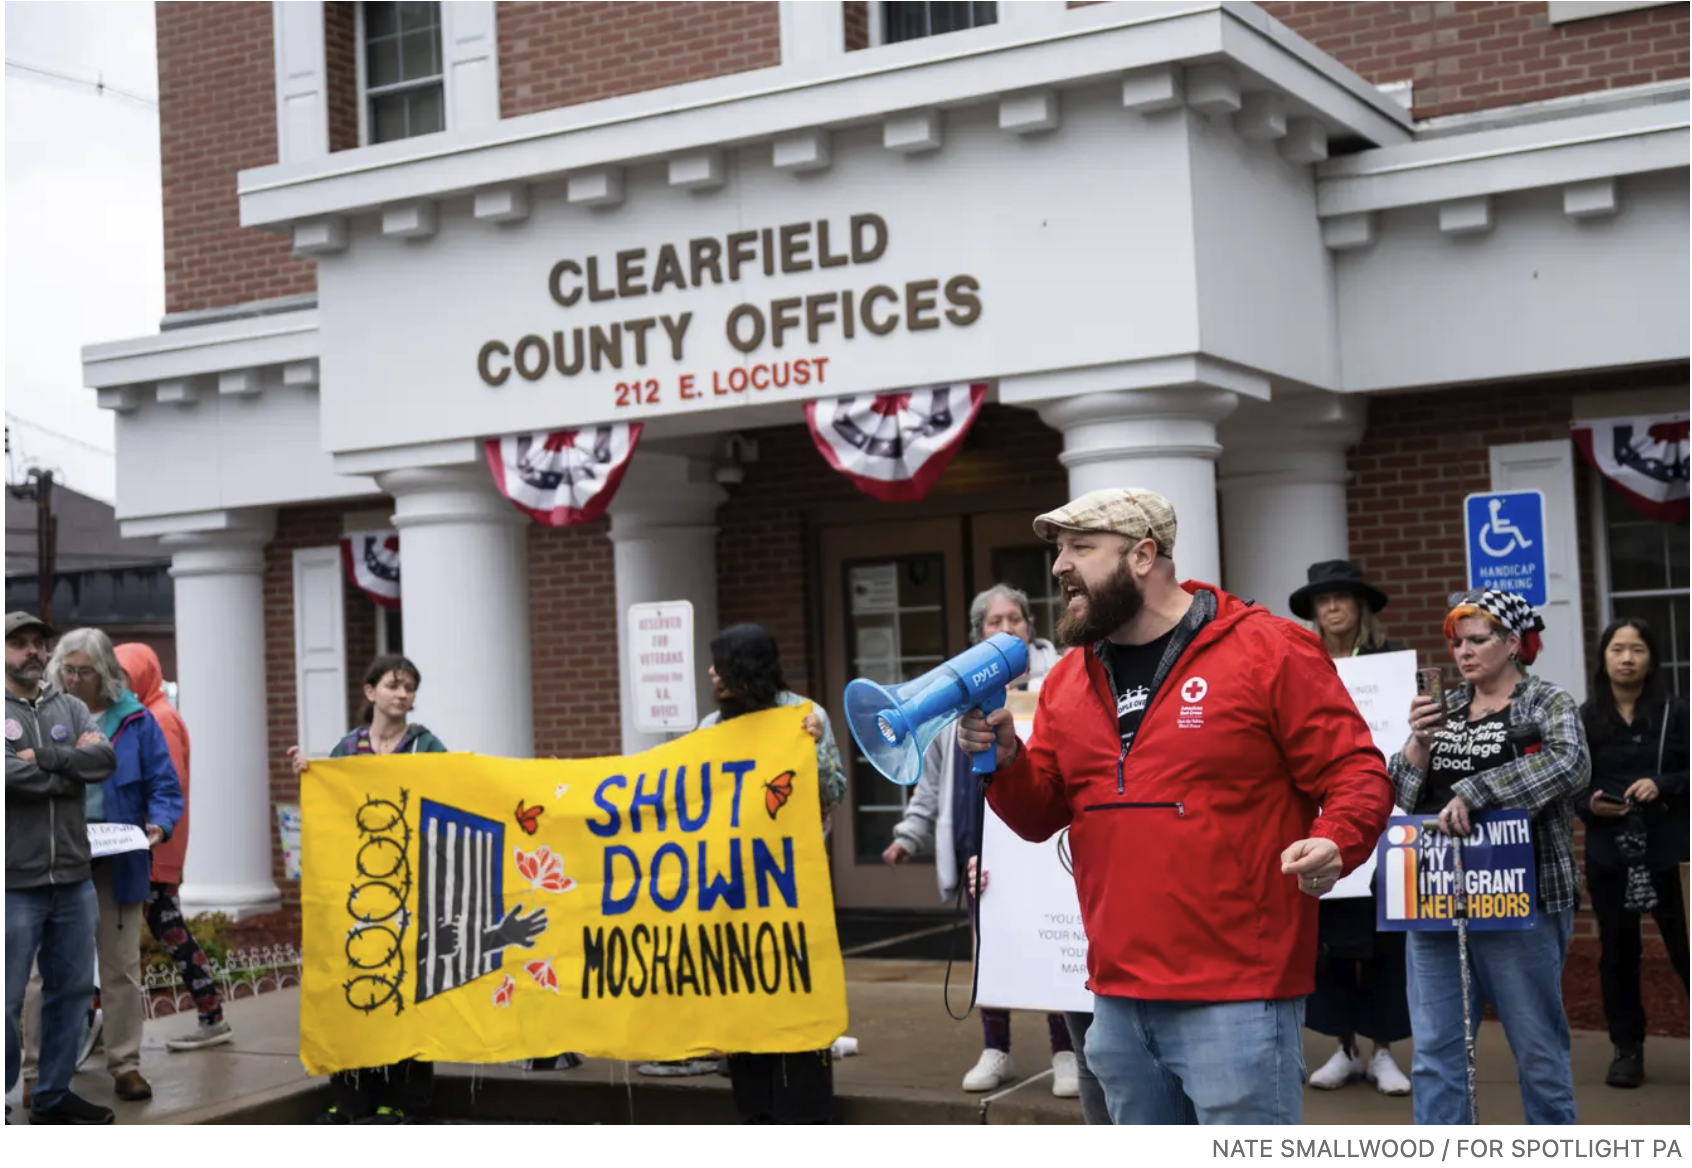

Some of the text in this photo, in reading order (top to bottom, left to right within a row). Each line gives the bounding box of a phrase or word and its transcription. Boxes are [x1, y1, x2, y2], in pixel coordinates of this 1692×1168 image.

[549, 213, 889, 307] CLEARFIELD
[477, 274, 982, 387] COUNTY OFFICES
[614, 357, 830, 407] 212 E. LOCUST
[1480, 563, 1536, 577] HANDICAP
[1484, 577, 1533, 590] PARKING
[639, 651, 684, 666] VETERANS
[972, 662, 1000, 687] PYLE
[1437, 741, 1501, 758] privilege
[1432, 756, 1475, 771] good.
[585, 760, 756, 838] SHUT
[1487, 819, 1531, 846] WITH
[1420, 848, 1447, 871] MY
[601, 836, 799, 916] DOWN
[1420, 868, 1526, 895] IMMGRANT
[1420, 893, 1531, 919] NEIHBORS
[1038, 929, 1070, 940] YOUR
[582, 921, 812, 999] MOSHANNON
